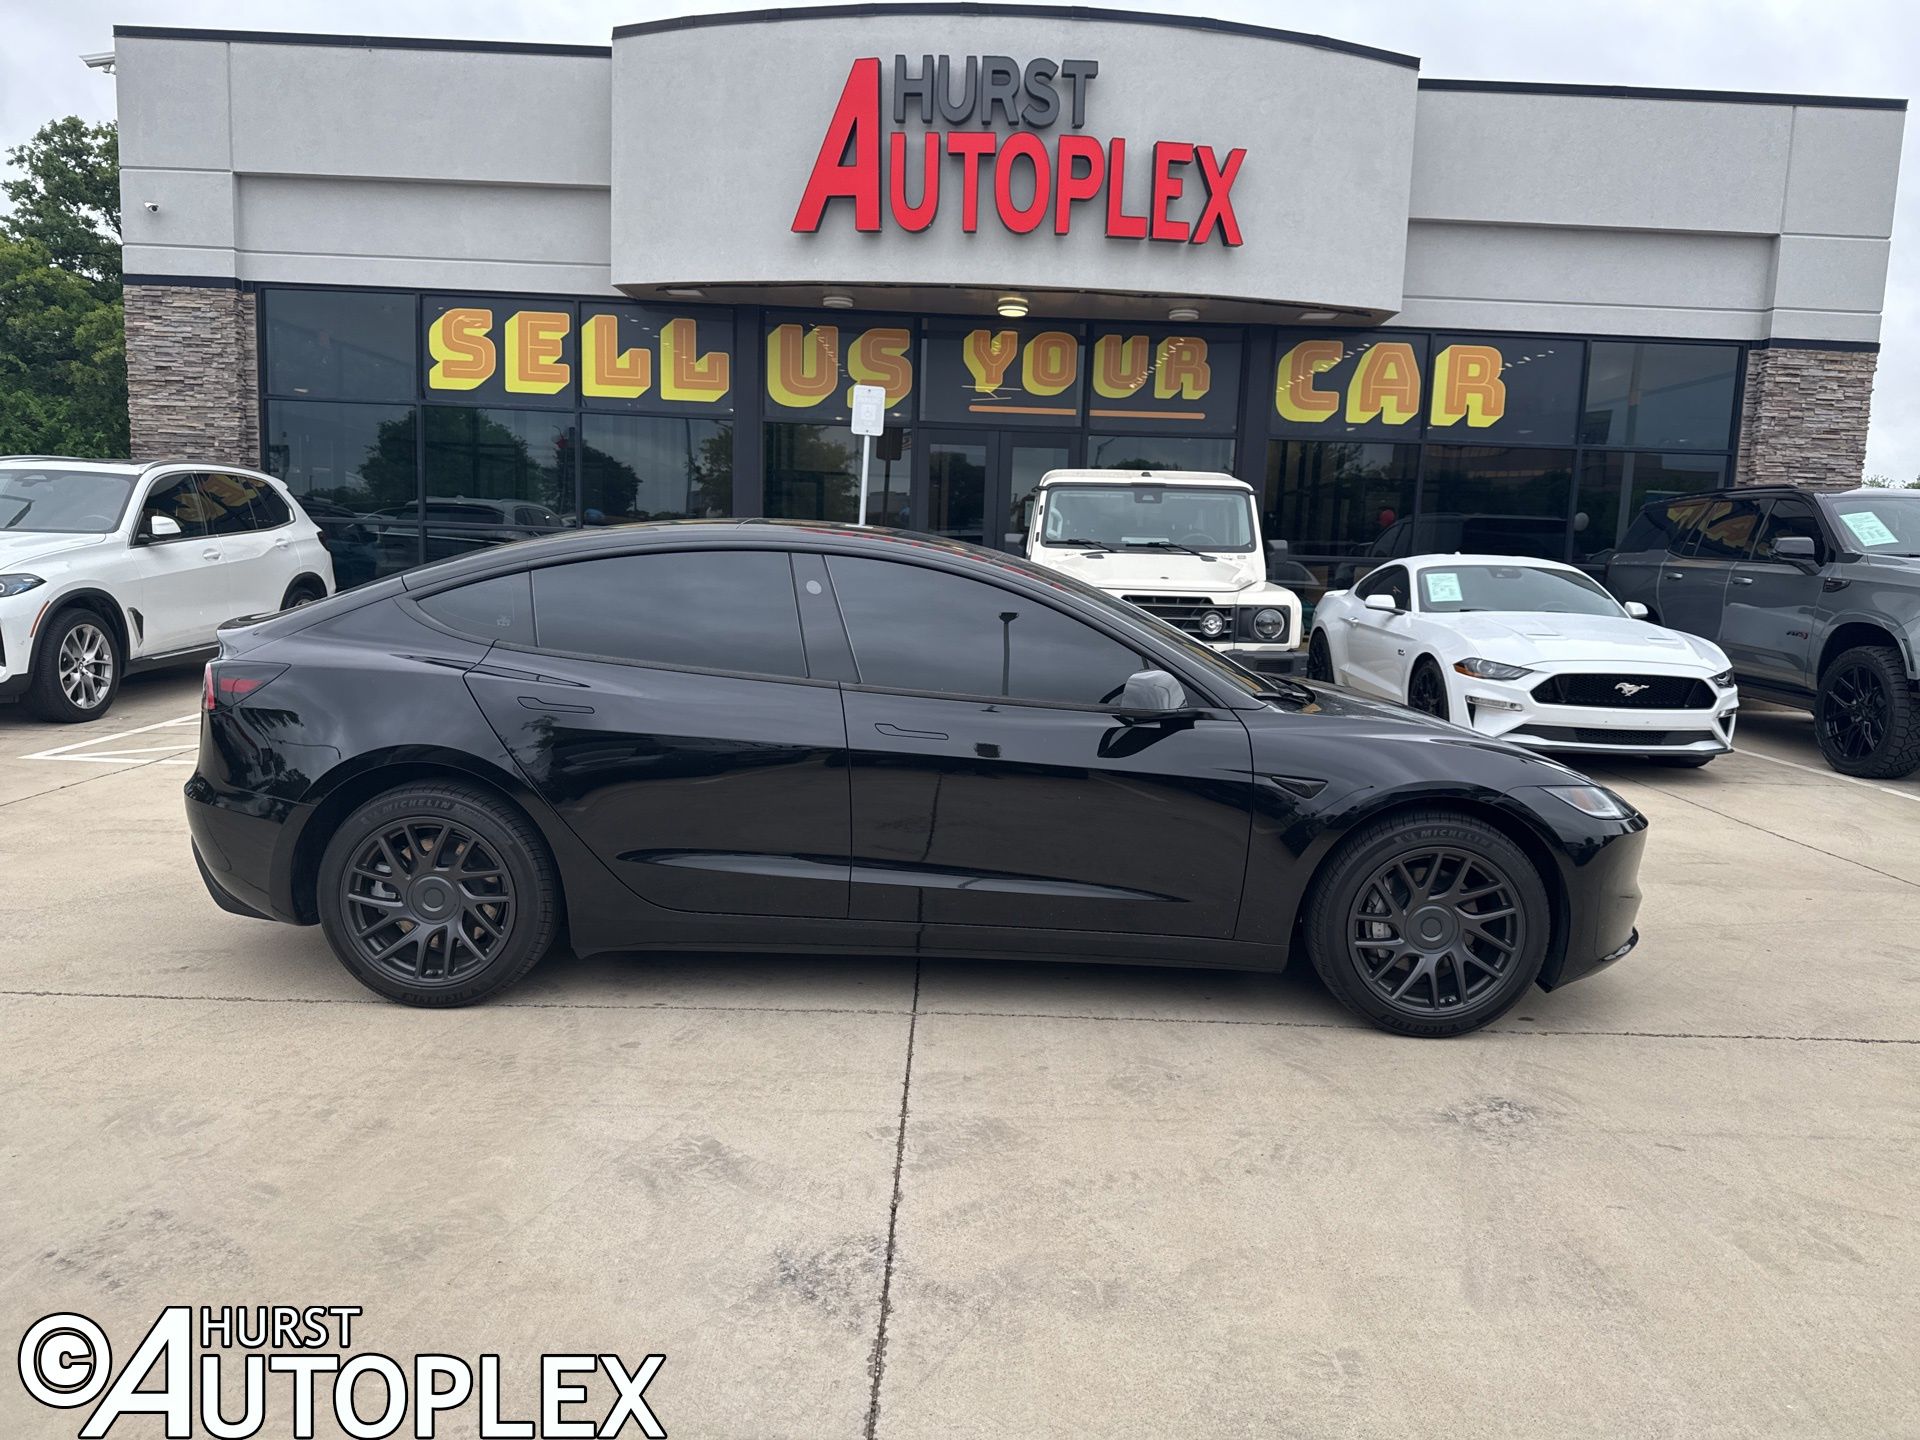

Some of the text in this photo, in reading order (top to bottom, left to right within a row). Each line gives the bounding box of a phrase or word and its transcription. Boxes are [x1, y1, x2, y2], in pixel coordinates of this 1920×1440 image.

[893, 54, 1098, 129] HURST
[791, 57, 1247, 247] AUTOPLEX
[428, 308, 1506, 428] SELL US YOUR CAR
[382, 799, 451, 814] MICHELIN
